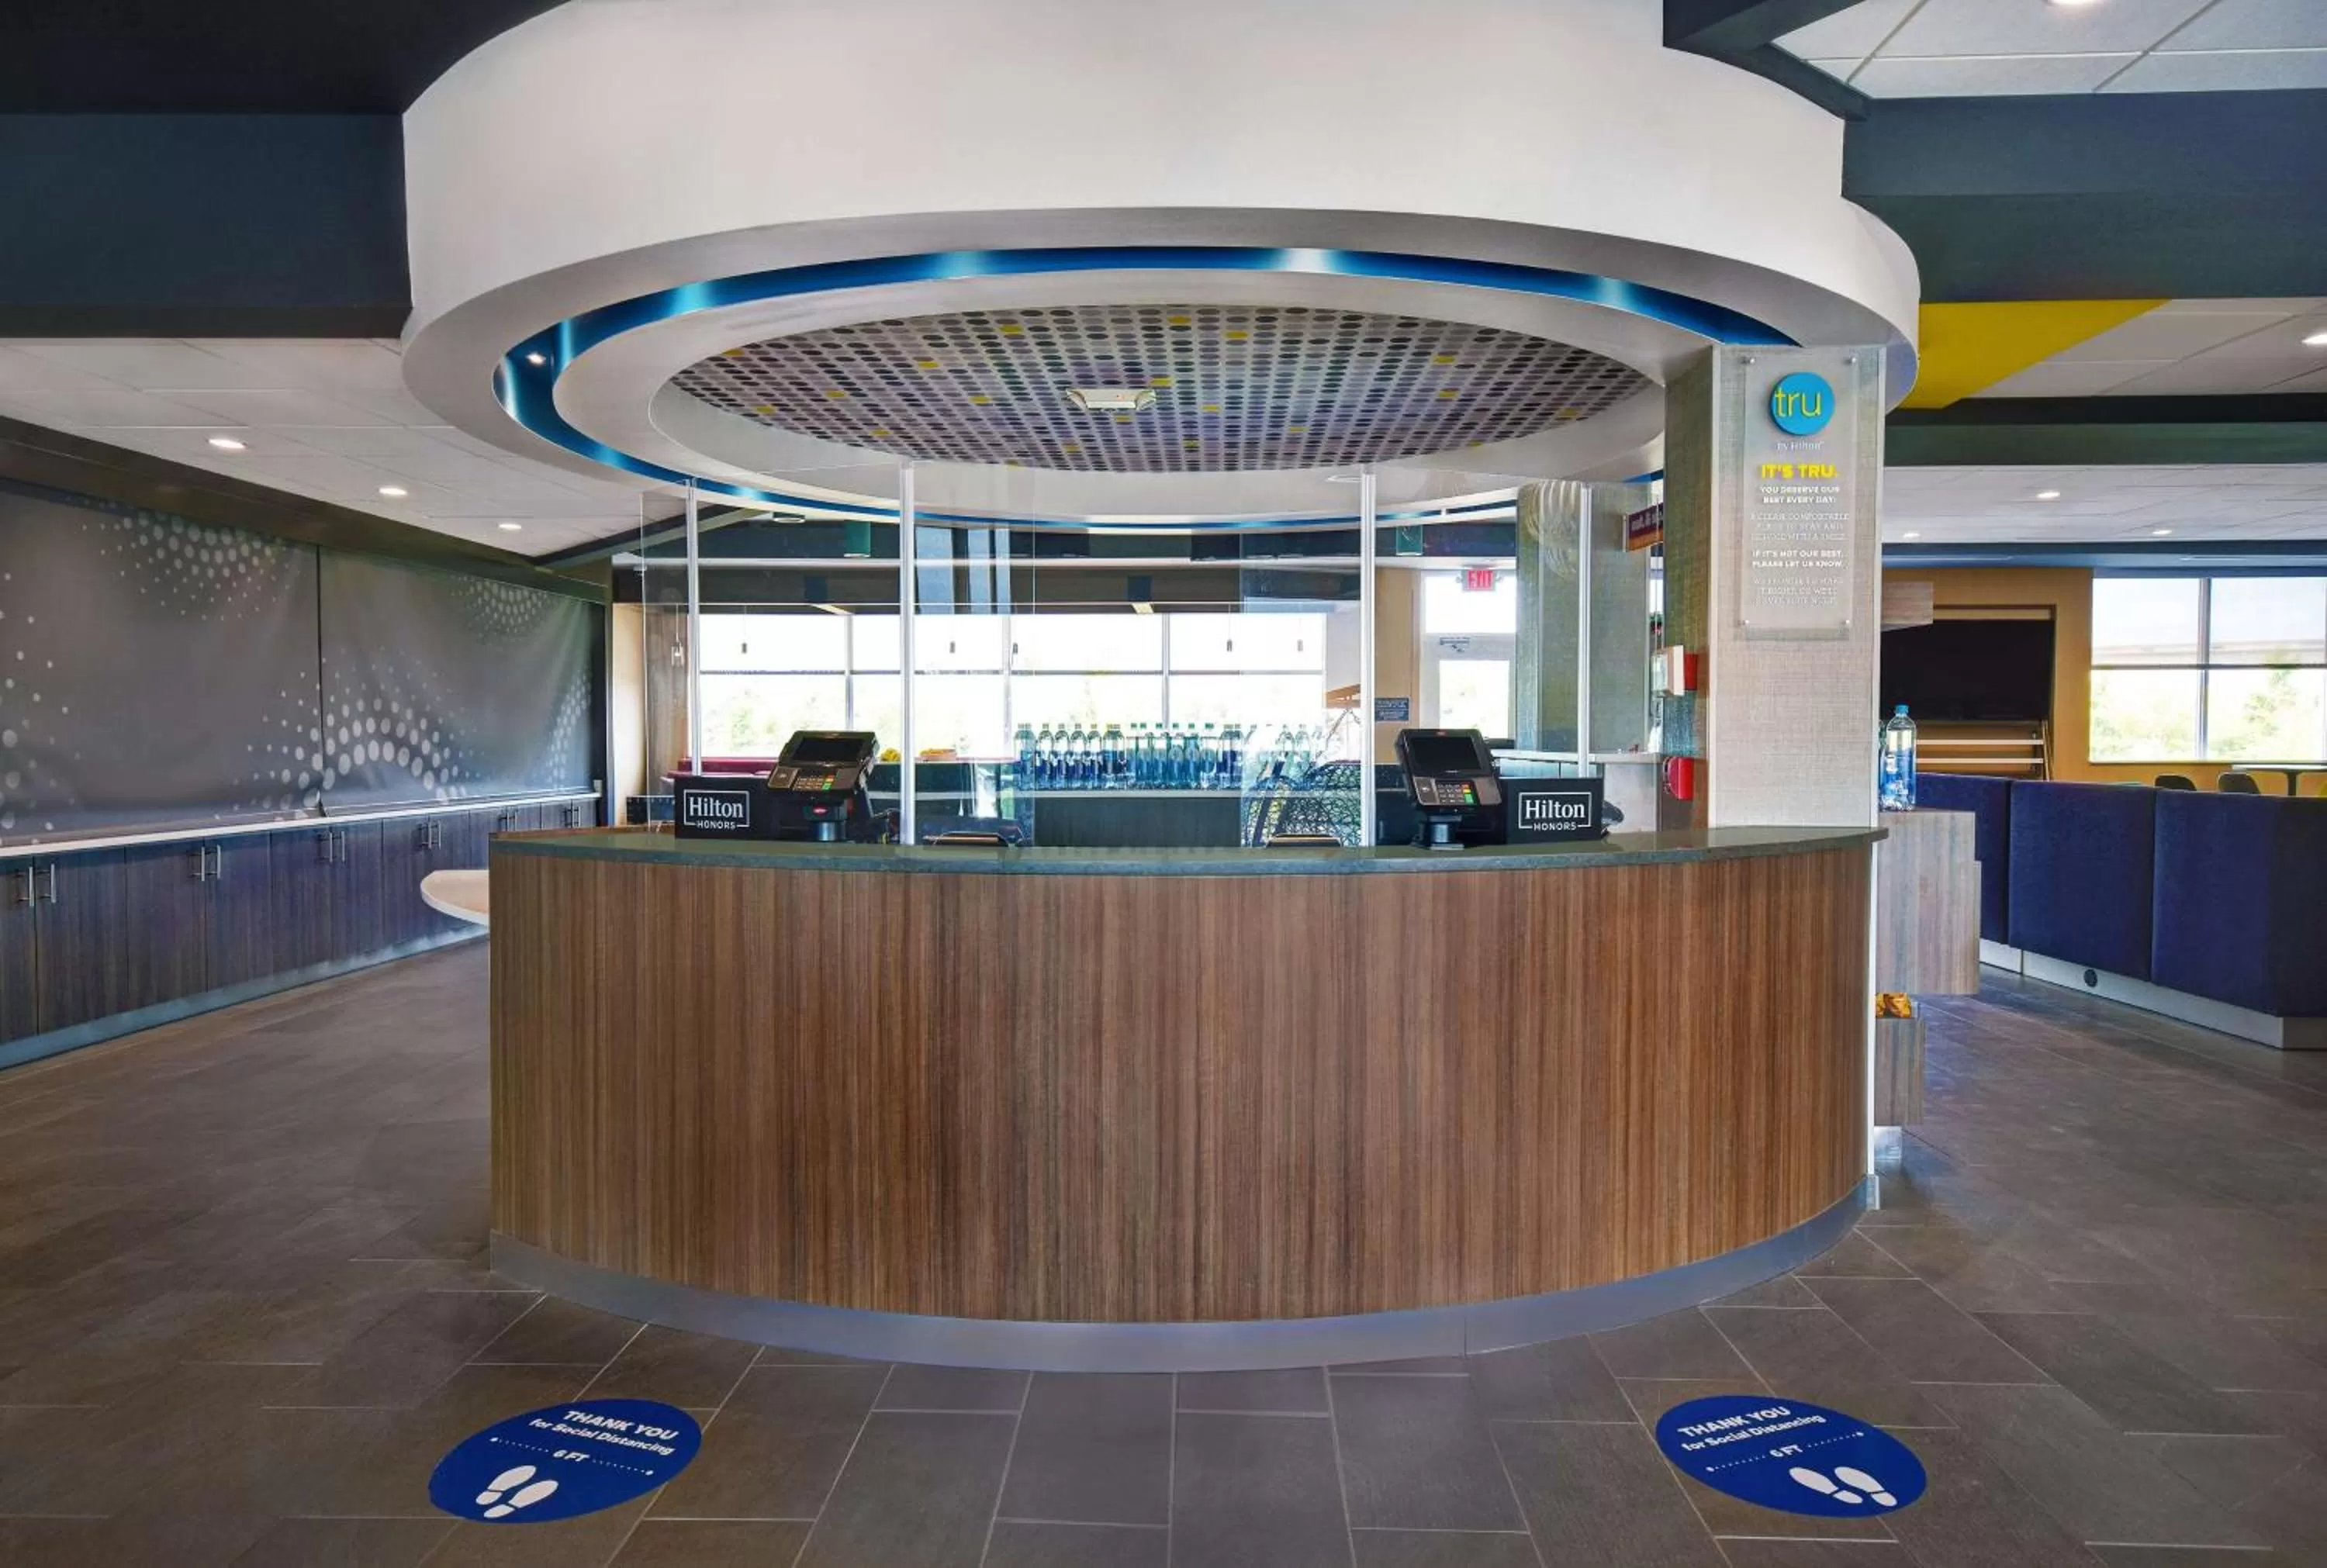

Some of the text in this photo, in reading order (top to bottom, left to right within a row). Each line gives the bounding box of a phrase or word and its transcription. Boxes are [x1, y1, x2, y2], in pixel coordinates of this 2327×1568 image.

[1775, 387, 1822, 418] tru
[1762, 465, 1839, 478] IT'S TRU.
[1468, 570, 1493, 589] EXIT
[689, 796, 744, 819] Hilton
[1525, 800, 1586, 820] Hilton
[697, 820, 736, 830] HONORS
[1533, 822, 1577, 831] HONORS
[562, 1411, 679, 1440] THANK YOU
[1677, 1406, 1792, 1438] THANK YOU
[528, 1418, 676, 1456] for Social Distancing
[1681, 1414, 1827, 1452] for Social Distancing
[552, 1449, 590, 1463] 6 FT
[1769, 1444, 1804, 1458] 6 FT
